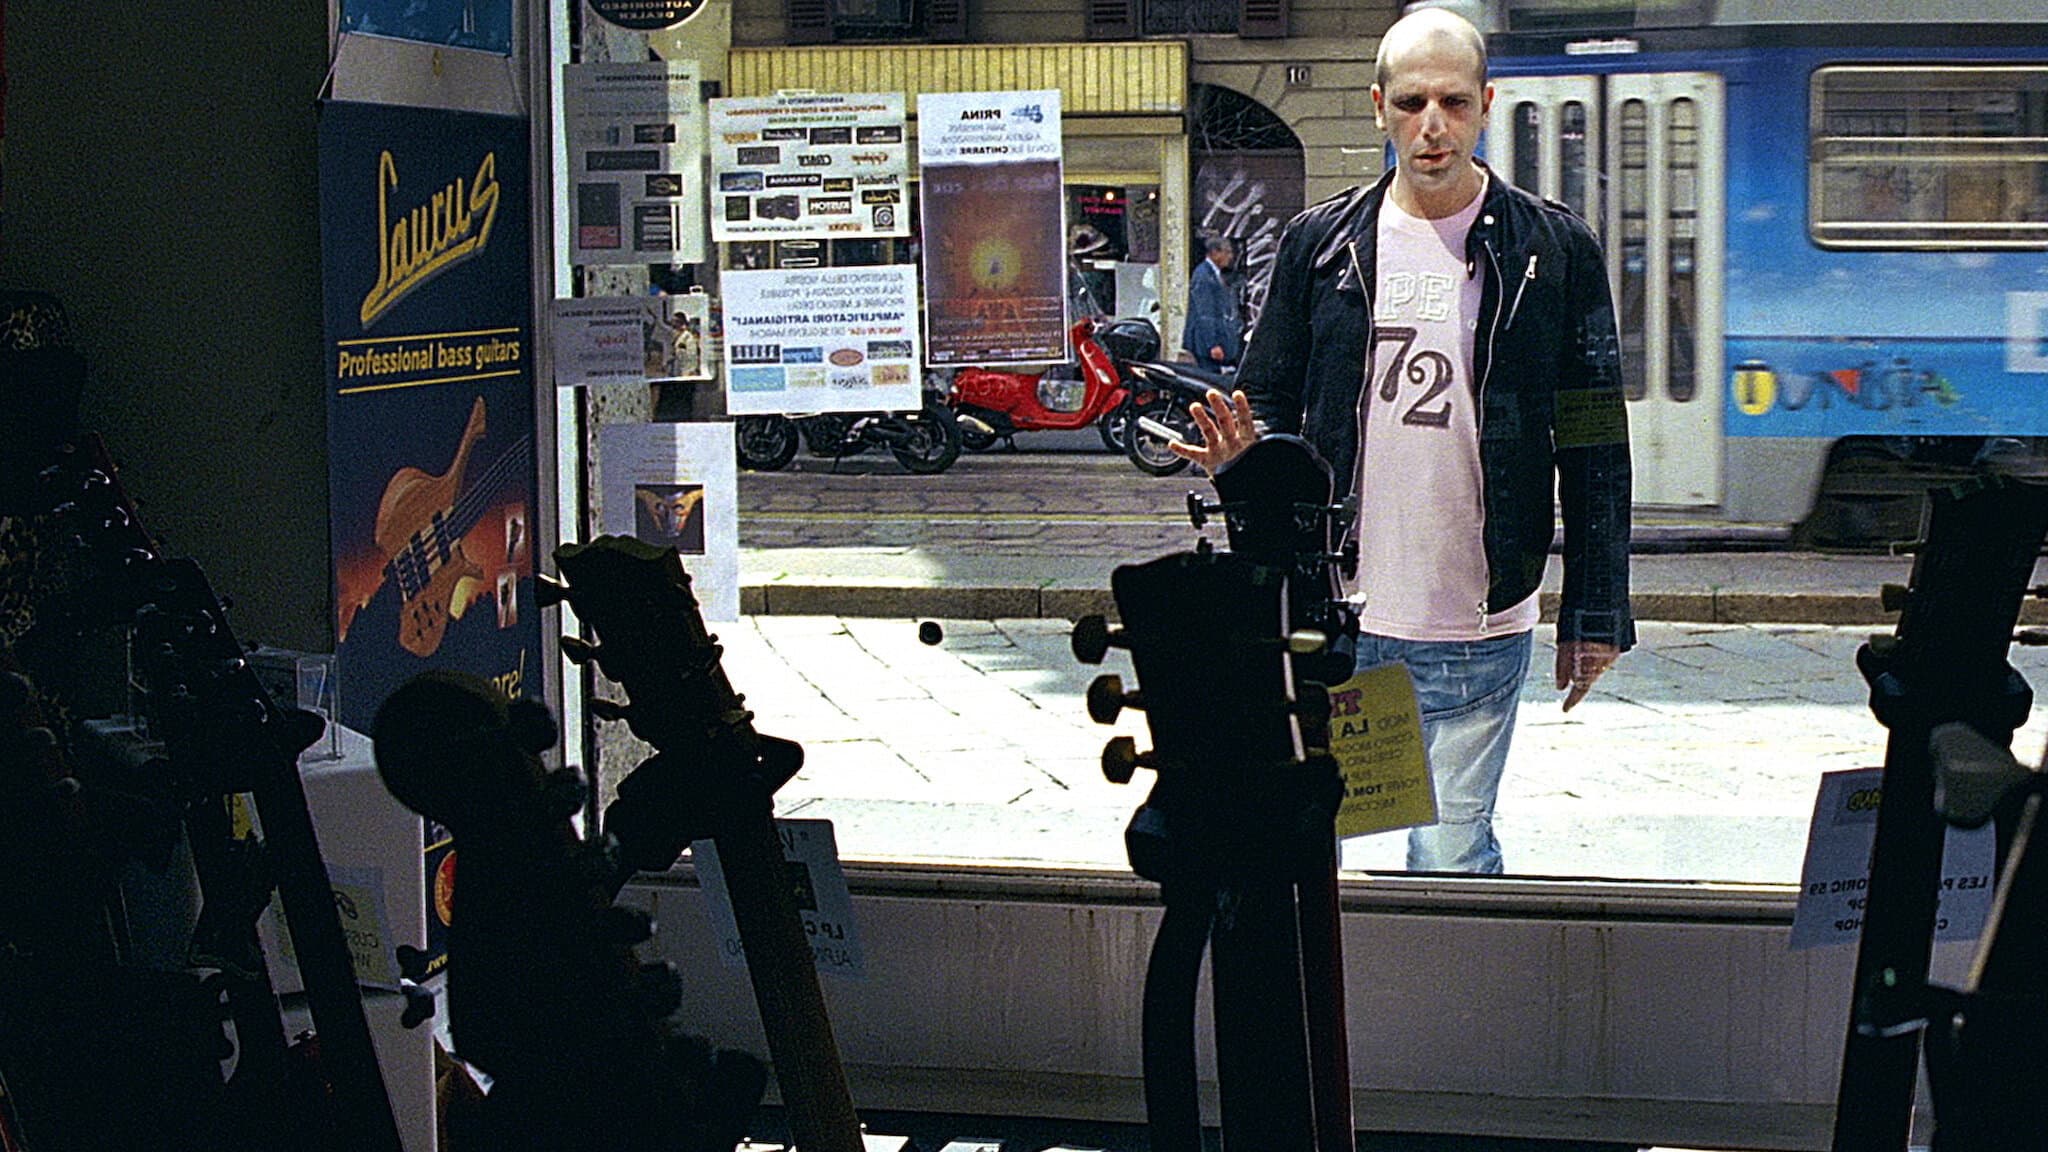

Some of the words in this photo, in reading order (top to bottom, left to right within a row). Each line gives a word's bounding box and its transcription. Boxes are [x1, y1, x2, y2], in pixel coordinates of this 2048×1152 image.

[1290, 67, 1309, 84] 10
[360, 150, 500, 326] Laurus
[338, 343, 435, 379] Professional
[437, 342, 473, 369] bass
[474, 337, 520, 371] guitars
[1374, 326, 1454, 429] 72
